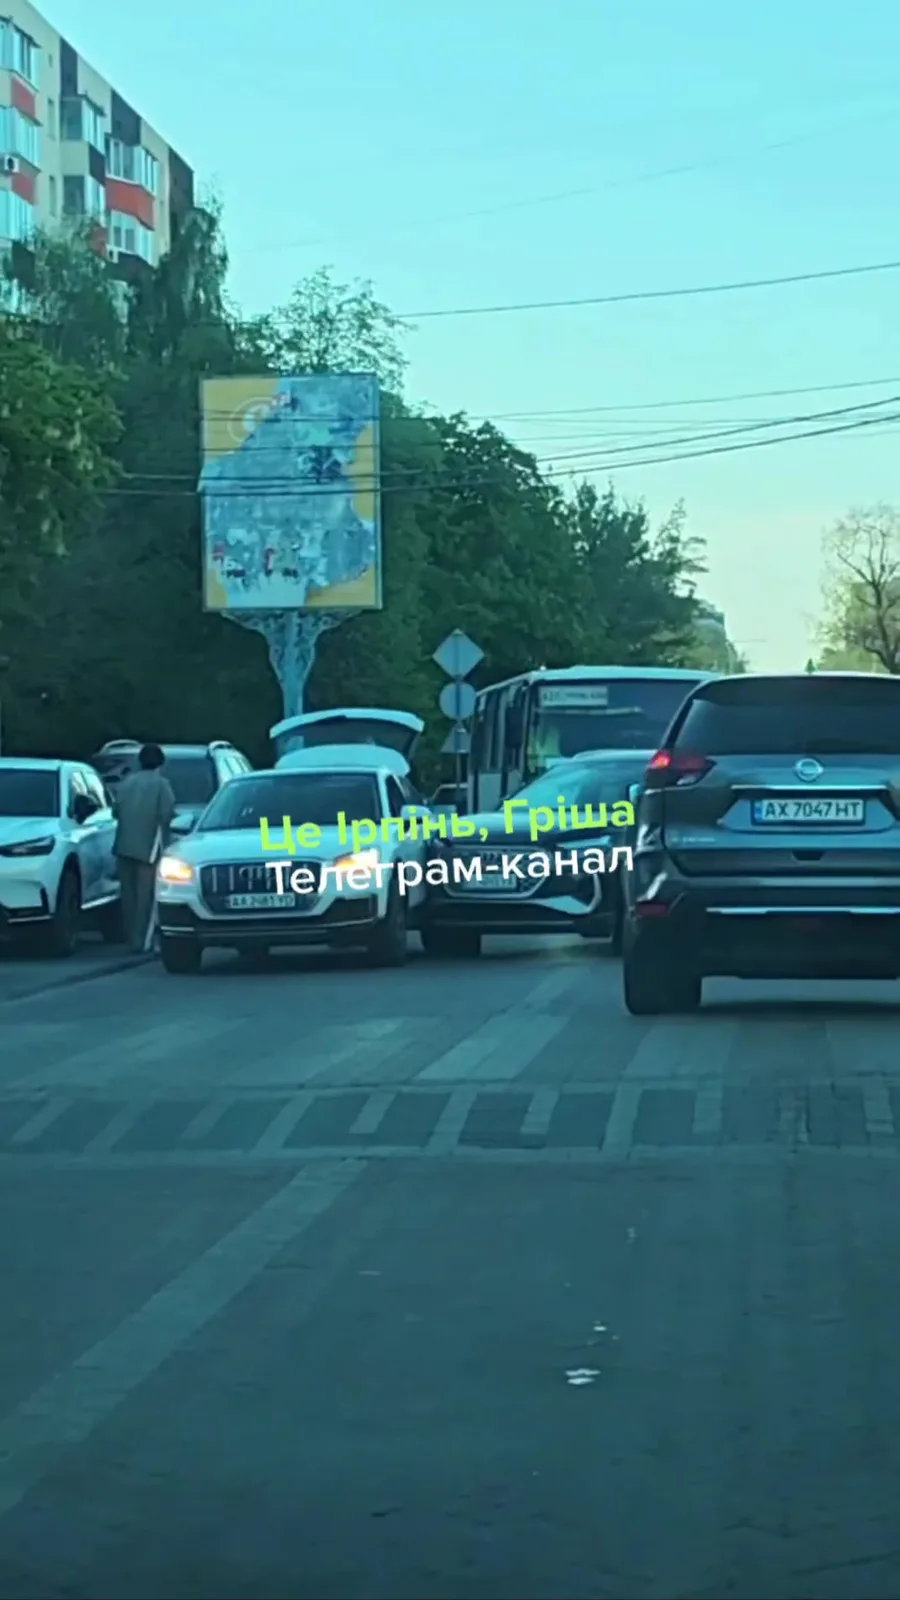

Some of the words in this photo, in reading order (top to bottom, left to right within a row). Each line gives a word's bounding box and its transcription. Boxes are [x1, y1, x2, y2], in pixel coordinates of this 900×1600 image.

[764, 801, 789, 818] AX
[793, 801, 833, 818] 7047
[835, 801, 861, 818] HT
